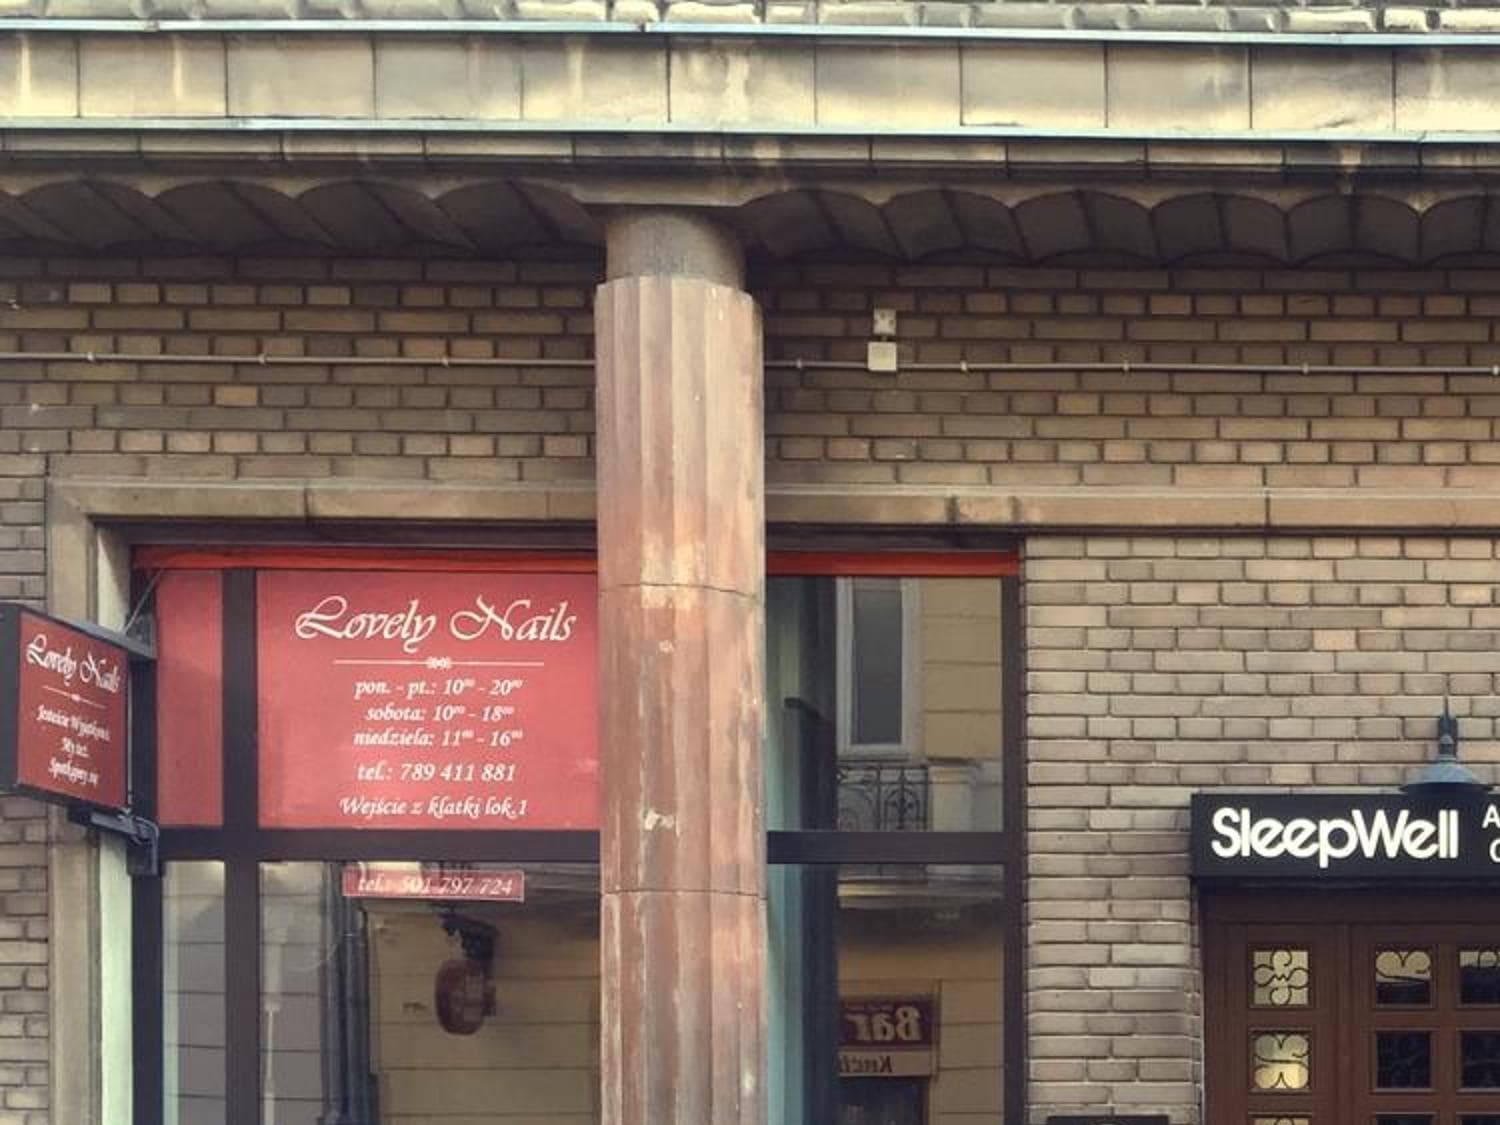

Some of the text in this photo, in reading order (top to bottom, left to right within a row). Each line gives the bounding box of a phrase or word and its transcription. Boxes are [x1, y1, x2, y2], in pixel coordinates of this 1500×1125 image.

[295, 594, 577, 653] Lovely Nails
[366, 702, 425, 721] sobota:
[353, 727, 434, 747] niedziela:
[400, 763, 436, 781] 789
[440, 763, 475, 782] 411
[481, 763, 516, 782] 881
[340, 797, 405, 820] Wejście
[410, 800, 424, 815] z
[427, 796, 481, 820] klatki
[1211, 806, 1458, 868] SleepWell
[439, 876, 474, 895] 797
[479, 877, 514, 896] 724
